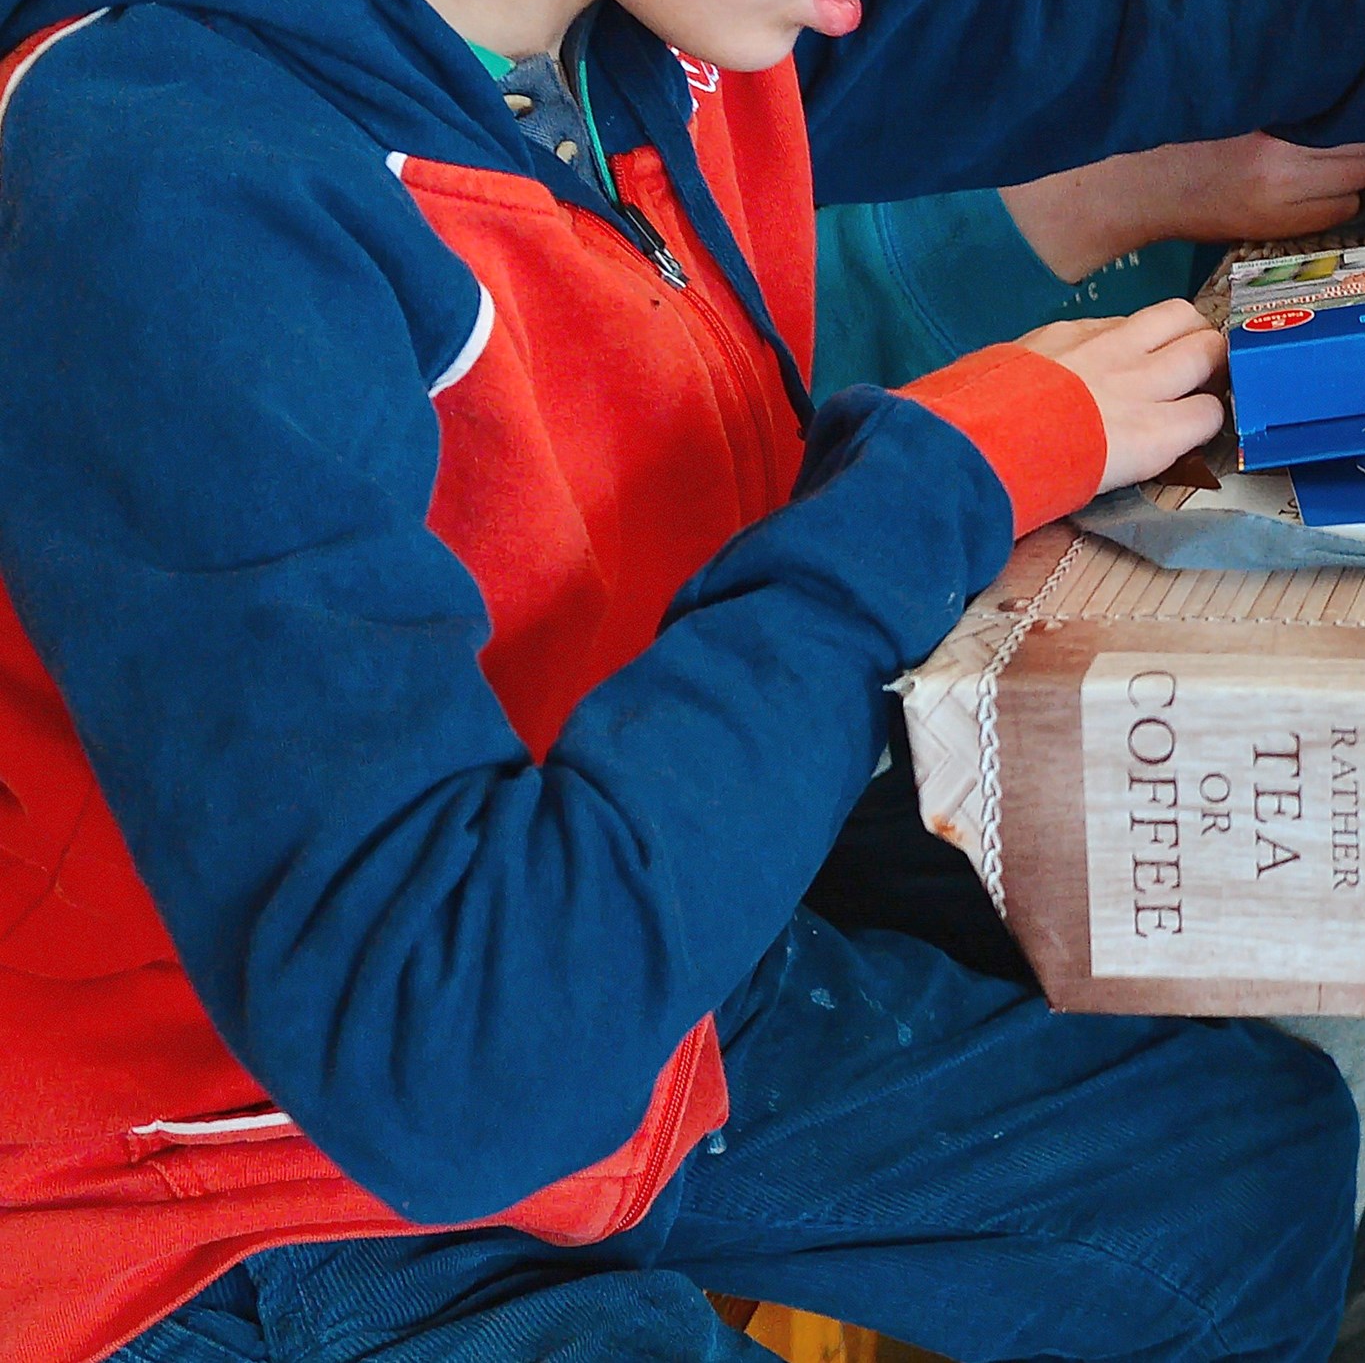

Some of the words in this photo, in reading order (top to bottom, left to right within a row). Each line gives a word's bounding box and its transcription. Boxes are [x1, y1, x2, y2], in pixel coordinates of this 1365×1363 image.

[1126, 669, 1184, 938] COFFEE
[1200, 772, 1230, 836] OR
[1252, 733, 1302, 881] TEA
[1331, 726, 1360, 891] RATHER
